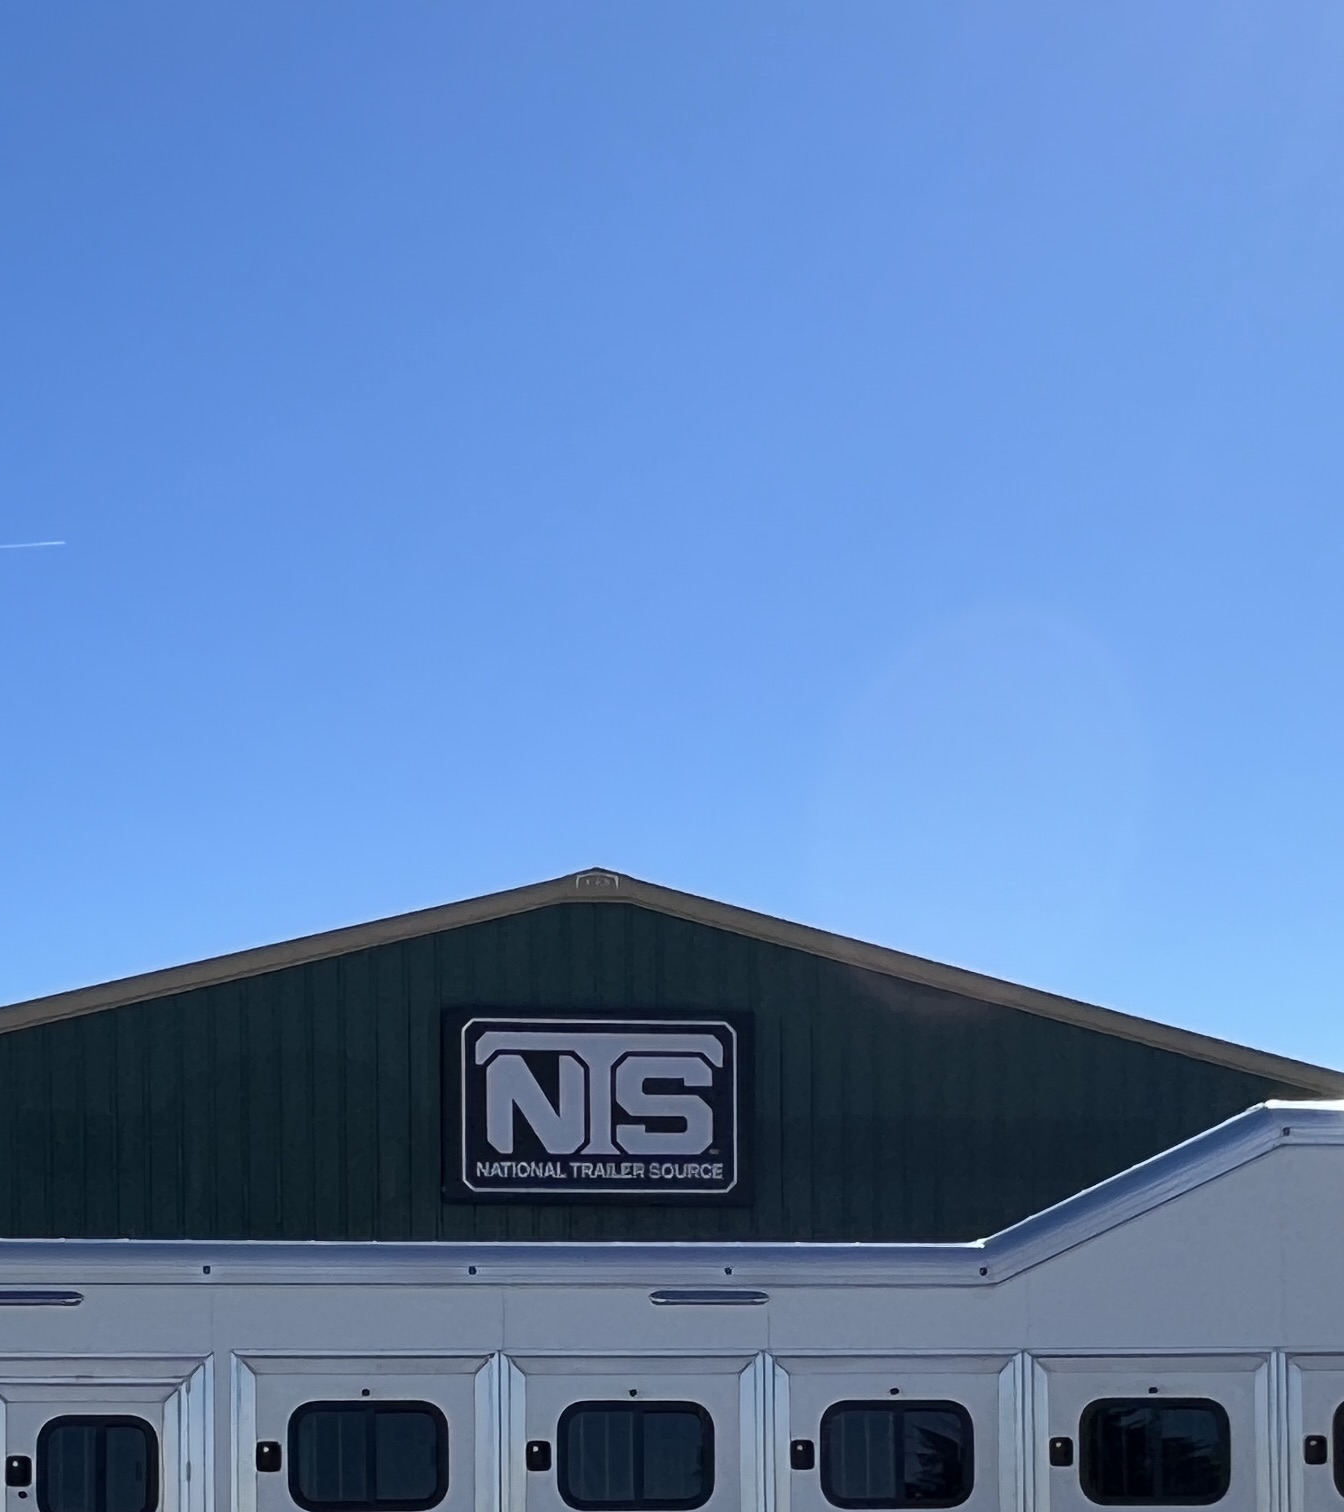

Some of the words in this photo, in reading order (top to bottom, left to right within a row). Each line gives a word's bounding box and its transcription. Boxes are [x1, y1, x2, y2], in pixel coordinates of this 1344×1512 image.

[475, 1031, 723, 1155] NTS
[476, 1161, 567, 1178] NATIONAL
[569, 1162, 645, 1179] TRAILER
[648, 1163, 724, 1180] SOURCE
